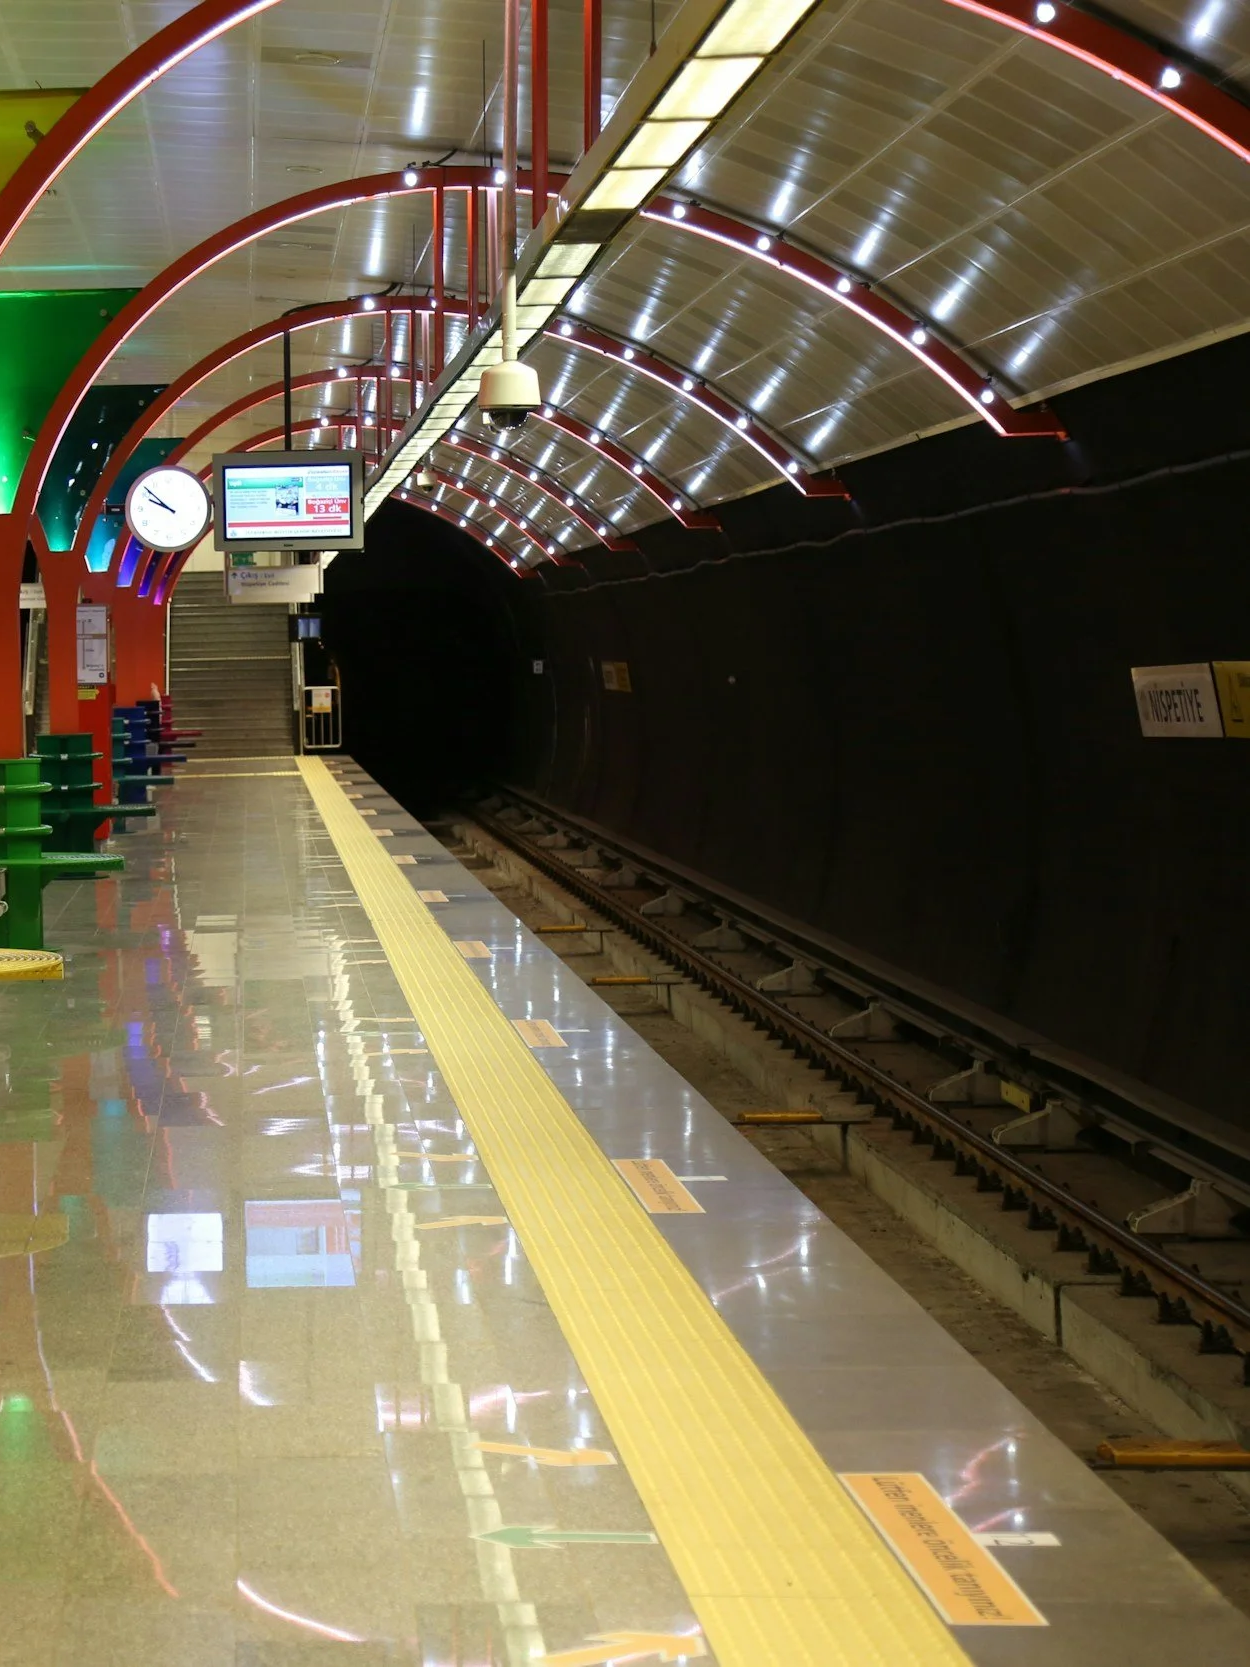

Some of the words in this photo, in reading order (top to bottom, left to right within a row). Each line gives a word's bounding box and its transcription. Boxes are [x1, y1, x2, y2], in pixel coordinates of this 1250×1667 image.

[313, 505, 326, 513] 13
[328, 504, 342, 512] dk
[1148, 680, 1205, 723] NİSPETİYE
